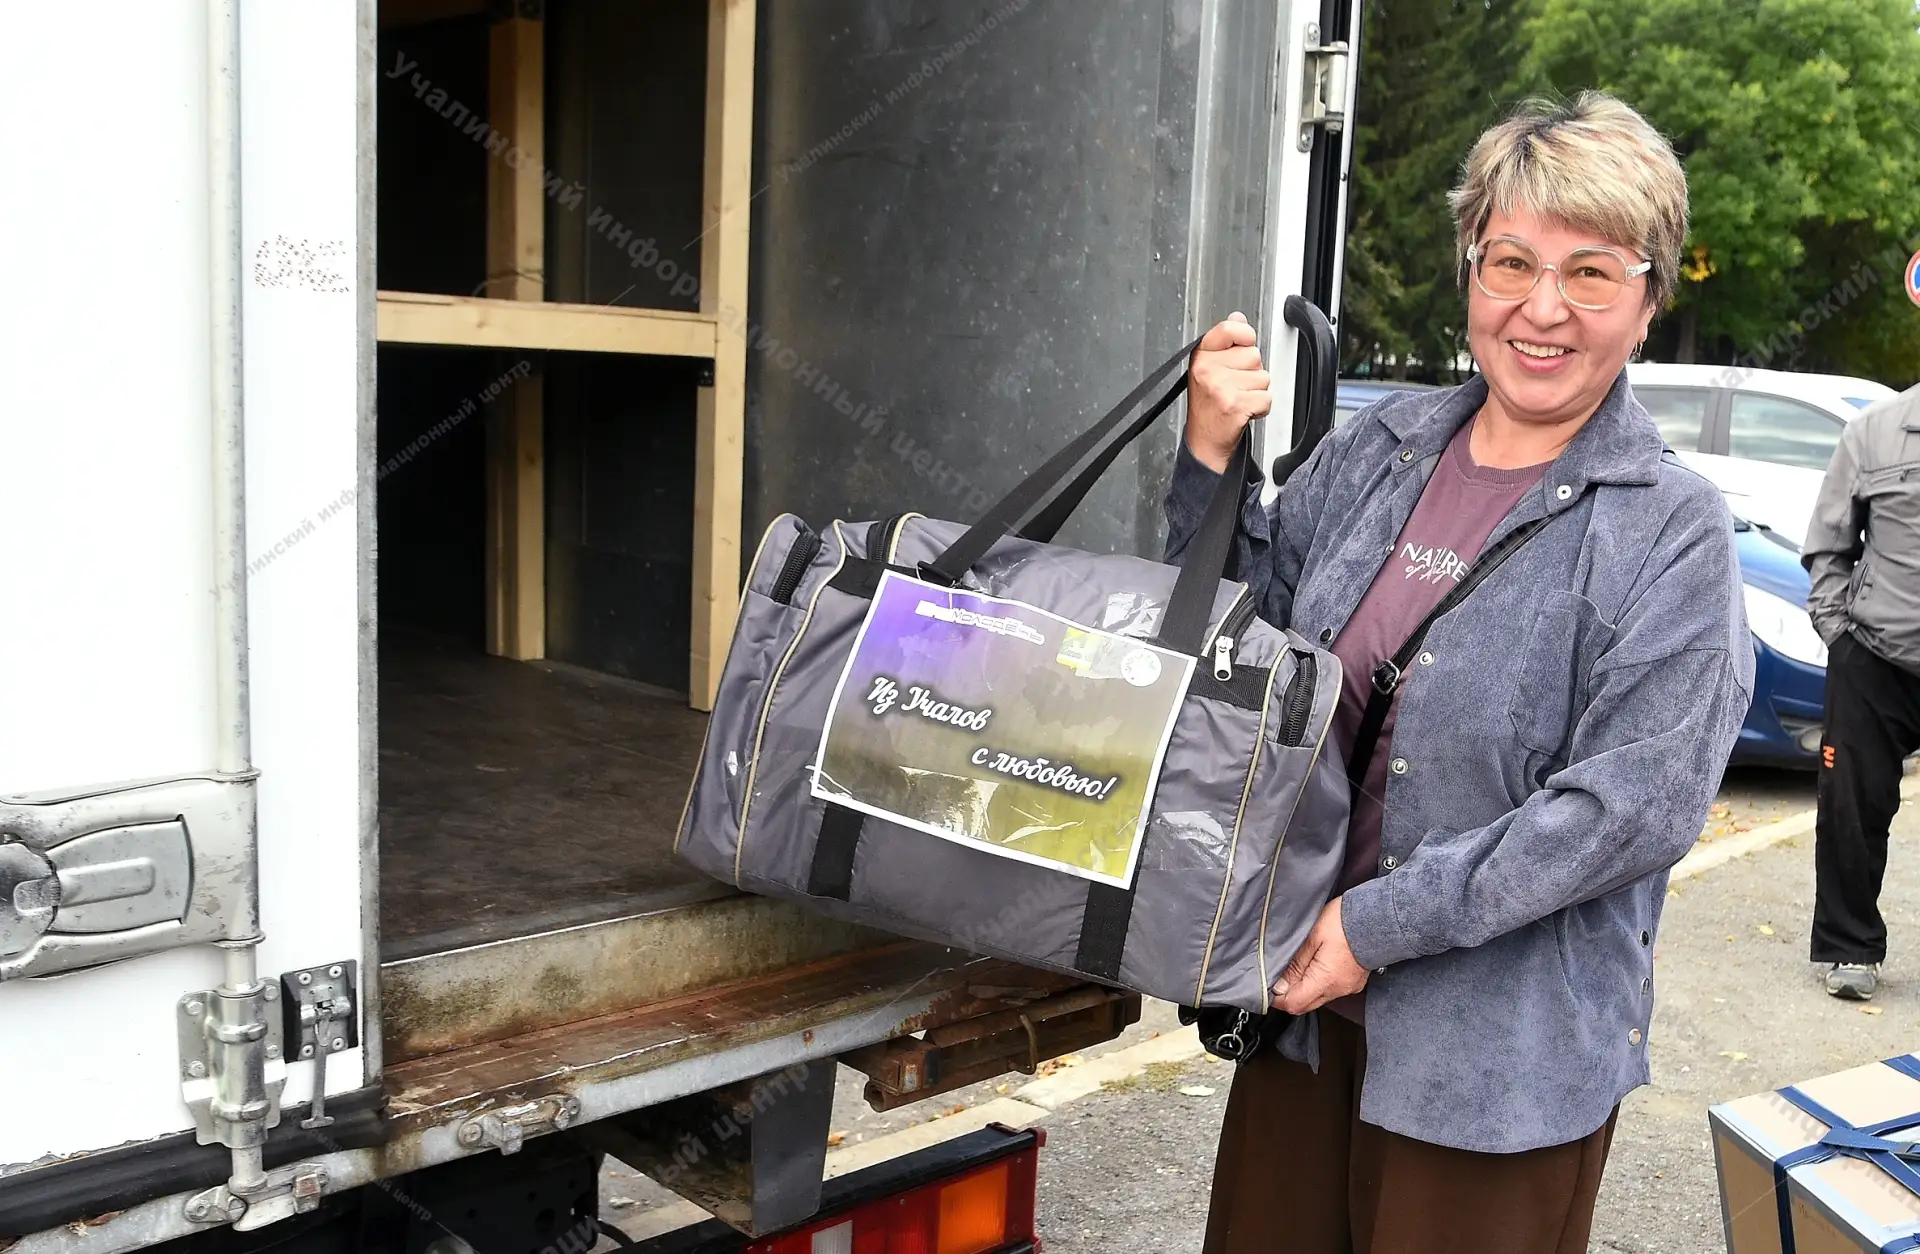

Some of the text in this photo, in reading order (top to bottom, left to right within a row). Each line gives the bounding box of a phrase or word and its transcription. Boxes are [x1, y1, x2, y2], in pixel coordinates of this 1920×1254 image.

[867, 675, 993, 731] Из Учалов
[971, 747, 1118, 801] с любовью!
